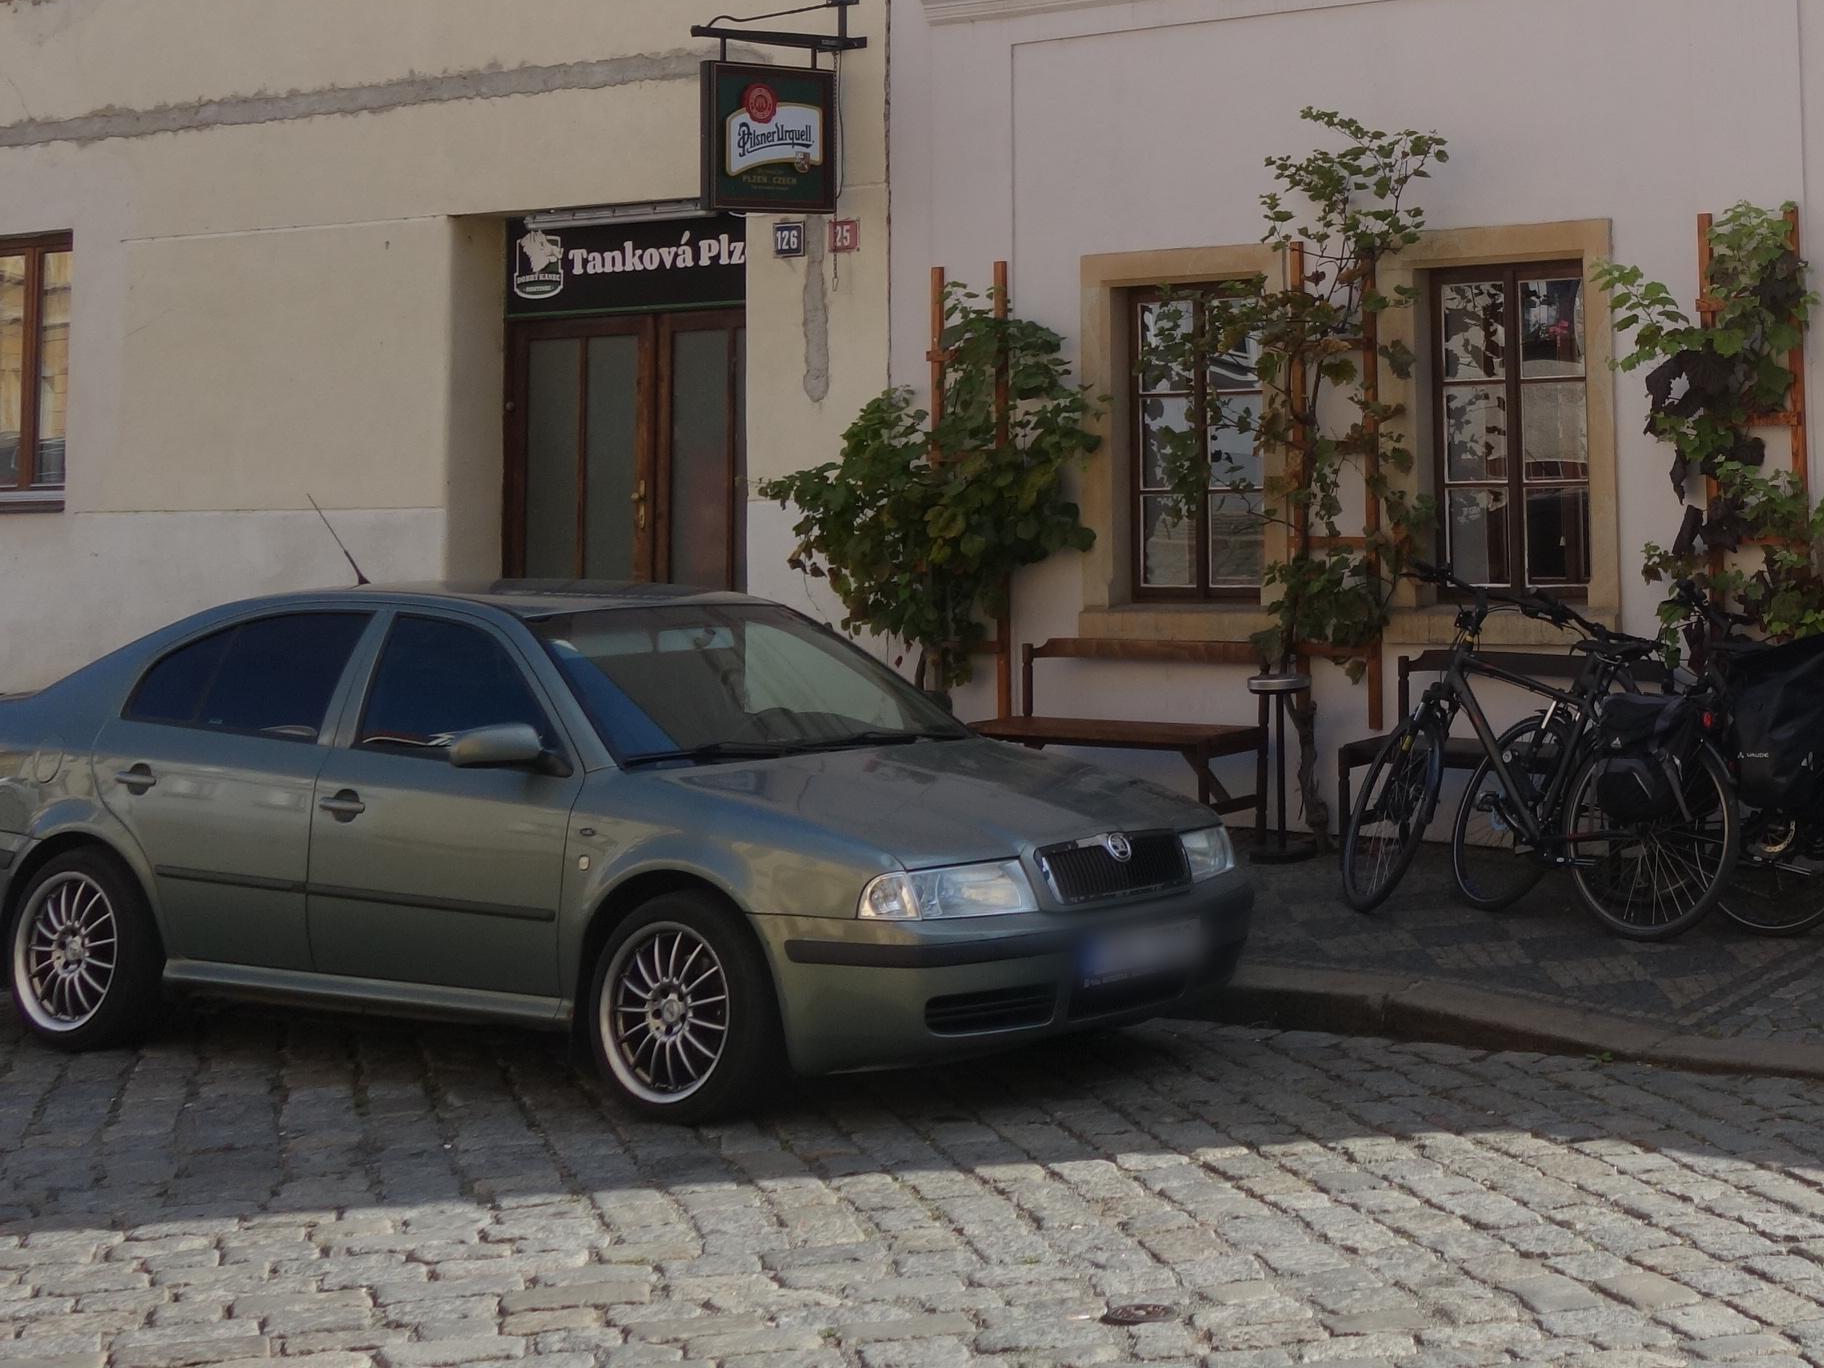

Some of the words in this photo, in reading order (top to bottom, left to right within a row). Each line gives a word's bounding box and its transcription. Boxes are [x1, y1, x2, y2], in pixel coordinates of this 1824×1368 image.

[737, 122, 776, 157] Pilsner
[775, 122, 812, 149] Urquell
[776, 230, 798, 250] 126
[836, 225, 850, 246] 25
[568, 230, 694, 275] Tanková
[698, 233, 746, 266] Plz
